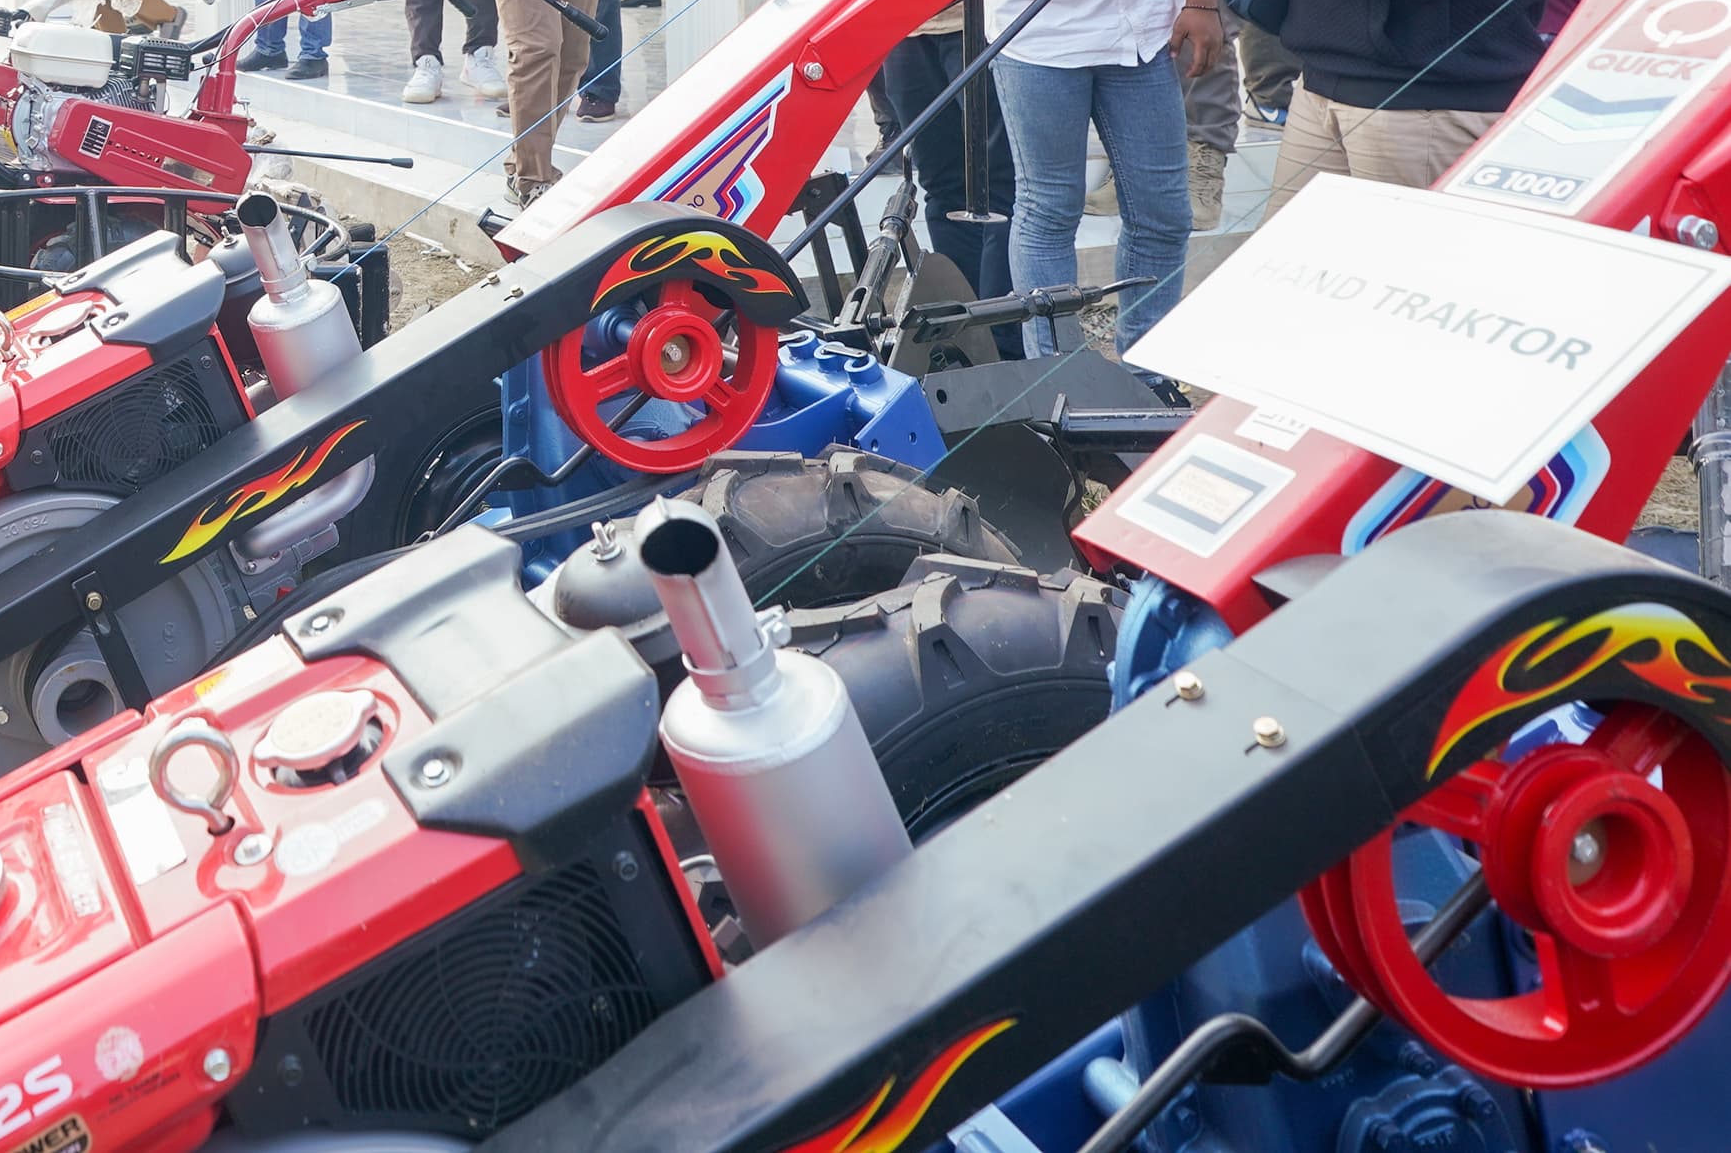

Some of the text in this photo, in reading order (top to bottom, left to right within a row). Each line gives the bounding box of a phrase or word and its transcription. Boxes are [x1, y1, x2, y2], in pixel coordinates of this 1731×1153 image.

[1585, 53, 1707, 81] QUICK
[1472, 167, 1576, 200] G 1000
[1252, 259, 1593, 370] HAND TRAKTOR
